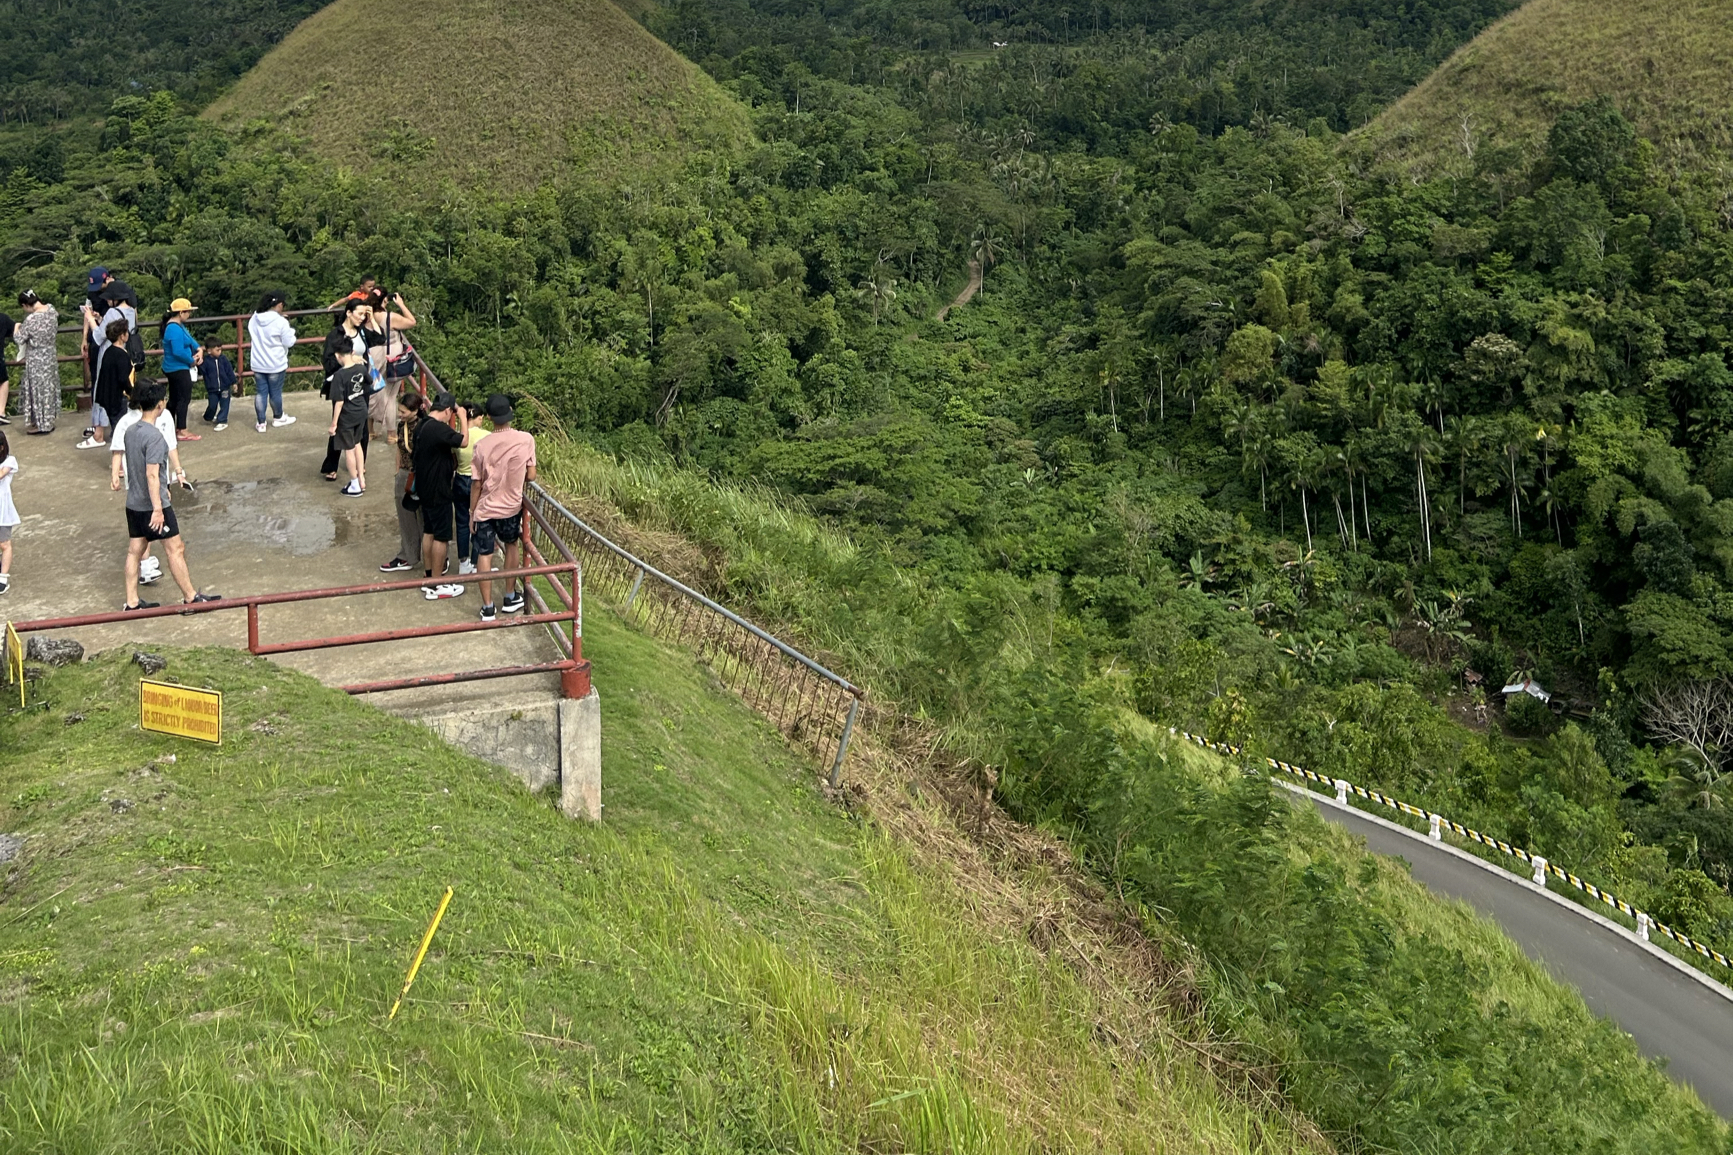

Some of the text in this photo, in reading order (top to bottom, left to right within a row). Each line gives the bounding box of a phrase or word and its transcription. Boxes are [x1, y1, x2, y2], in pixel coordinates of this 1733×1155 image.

[143, 690, 173, 708] BRINGING
[144, 709, 217, 735] IS STRICTLY PROHIBITED
